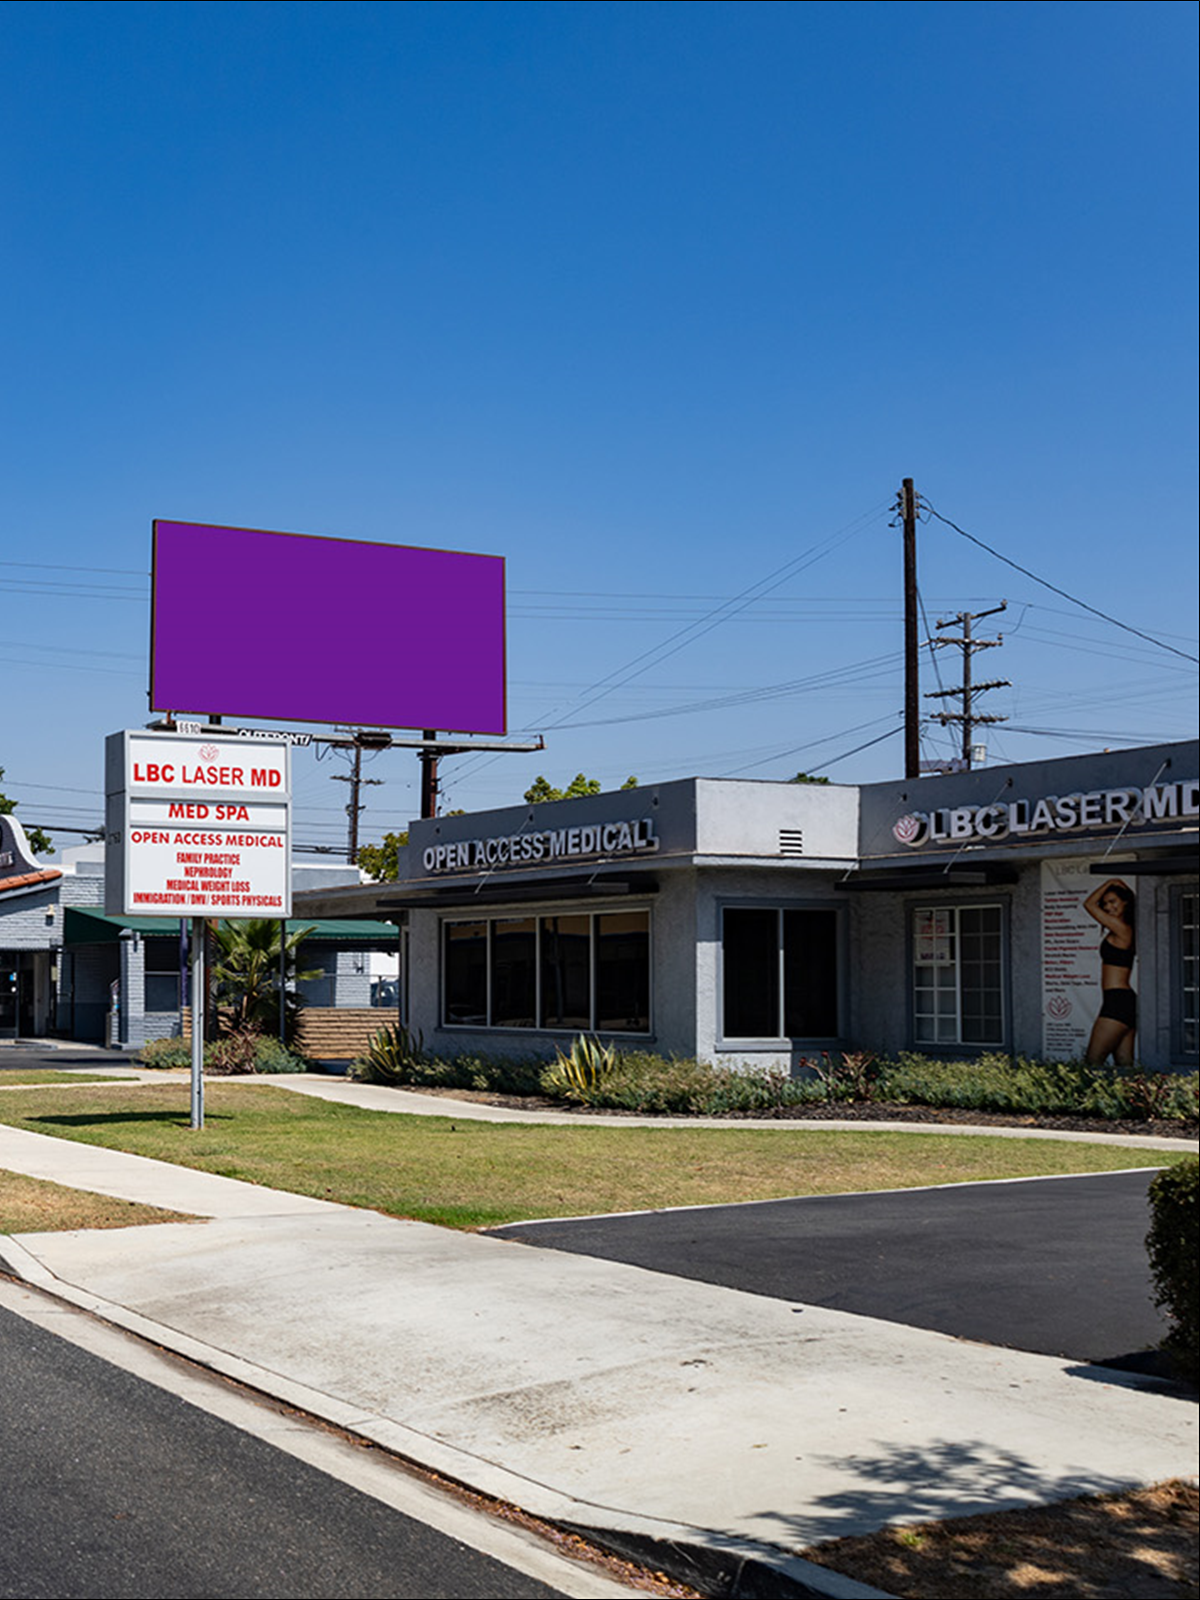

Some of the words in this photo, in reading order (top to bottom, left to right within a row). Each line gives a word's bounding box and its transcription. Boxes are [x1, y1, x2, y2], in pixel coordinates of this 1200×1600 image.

[133, 763, 175, 783] LBC
[181, 765, 244, 785] LASER
[250, 768, 282, 788] MD
[168, 803, 210, 820] MED
[215, 805, 250, 821] SPA
[929, 806, 1001, 841] LBC
[1008, 791, 1132, 833] LASER
[131, 831, 170, 844] OPEN
[173, 832, 222, 846] ACCESS
[225, 834, 284, 848] MEDICAL
[422, 841, 470, 871] OPEN
[474, 832, 545, 866] ACCESS
[550, 819, 649, 858] MEDICAL
[176, 852, 203, 864] FAMILY
[204, 853, 241, 866] PRACTICE
[184, 866, 234, 878] NEPHROLOGY
[166, 879, 200, 891] MEDICAL
[201, 880, 231, 892] WEIGHT
[231, 881, 251, 893] LOSS
[133, 892, 186, 905] IMMIGRATION
[211, 894, 241, 906] SPORTS
[242, 894, 282, 907] PHYSICALS
